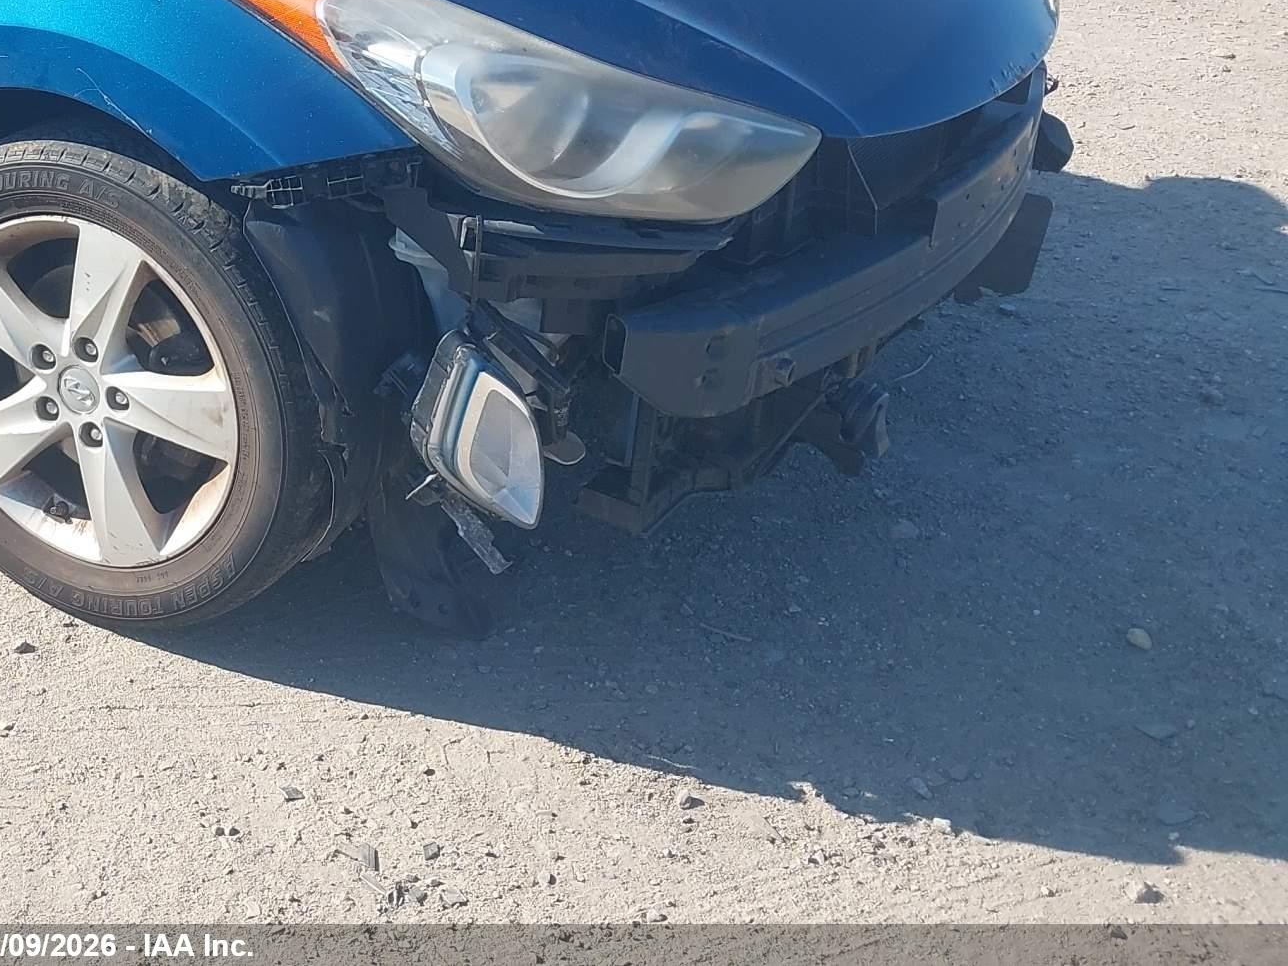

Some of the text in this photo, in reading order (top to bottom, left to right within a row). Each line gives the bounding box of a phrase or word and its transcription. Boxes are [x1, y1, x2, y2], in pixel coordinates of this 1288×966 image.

[79, 179, 120, 210] A/S
[170, 553, 237, 609] ASPEN
[72, 590, 165, 618] TOURING
